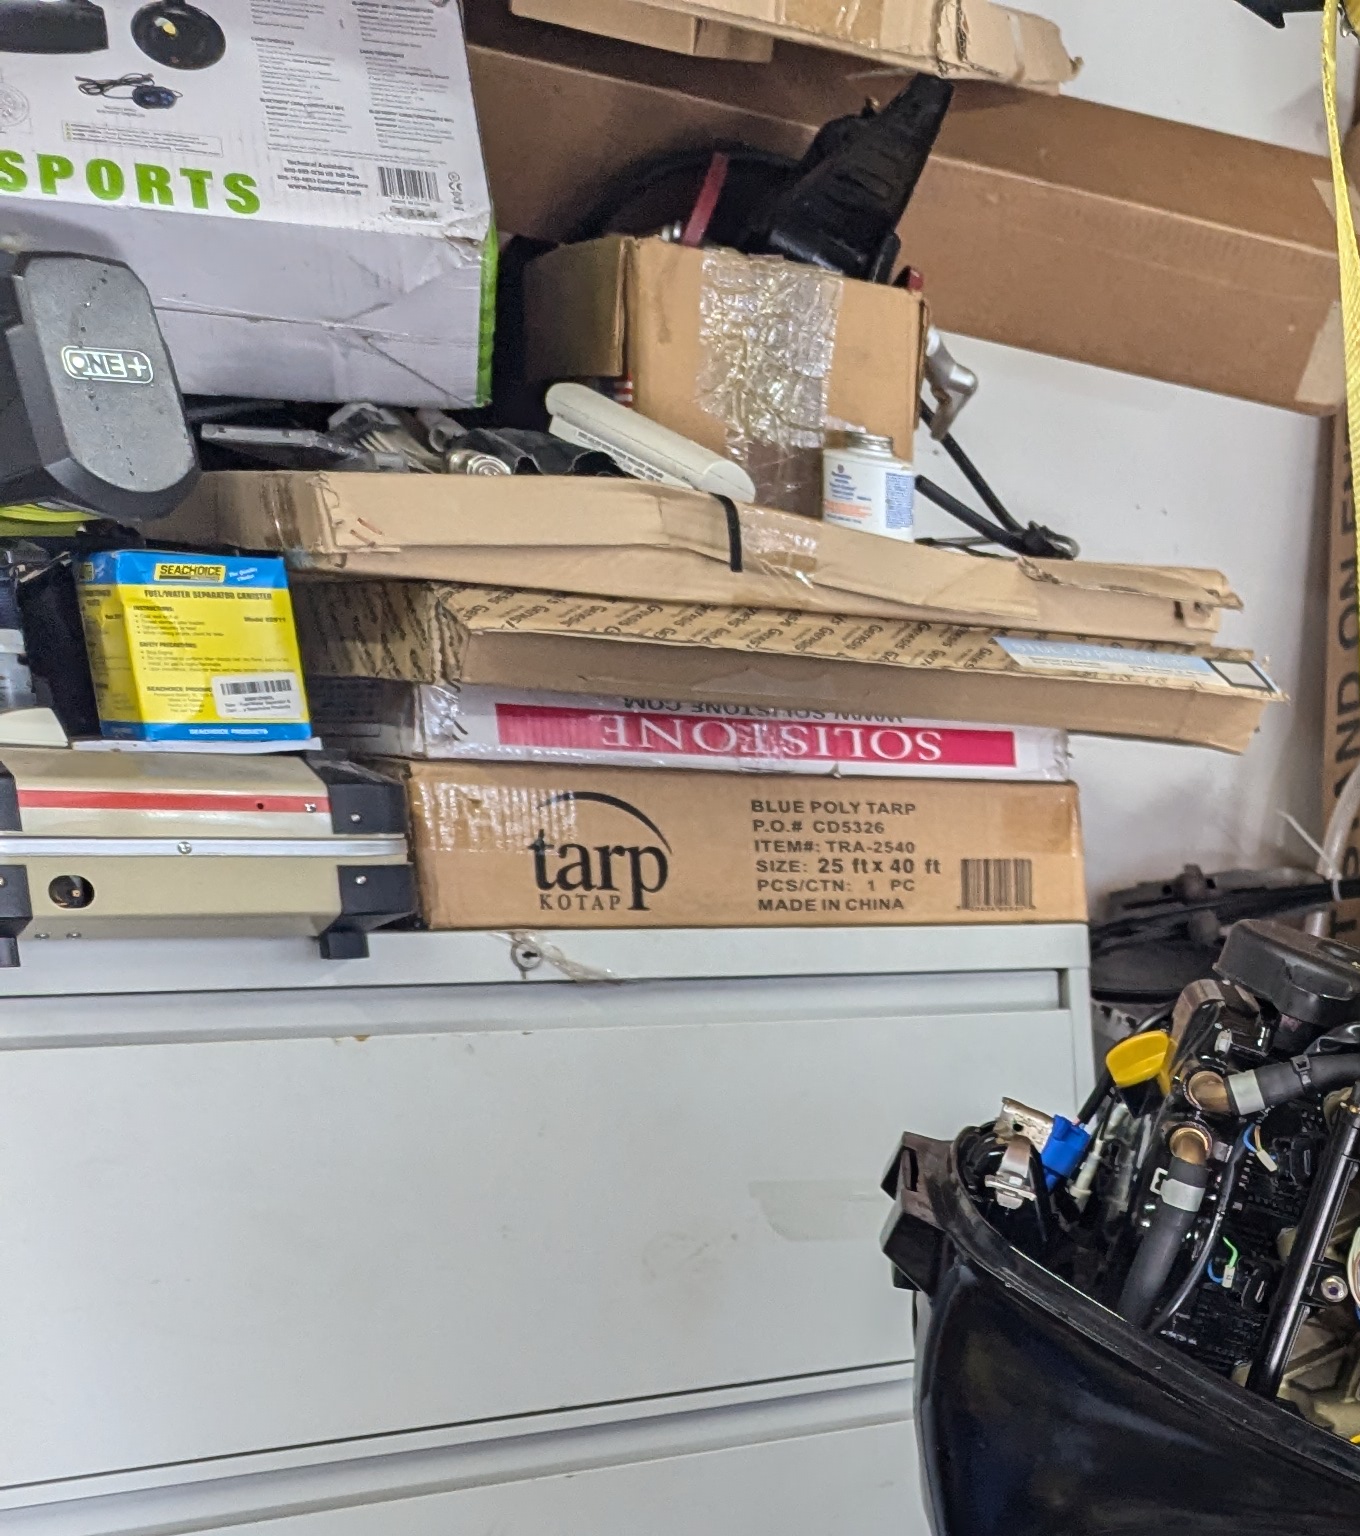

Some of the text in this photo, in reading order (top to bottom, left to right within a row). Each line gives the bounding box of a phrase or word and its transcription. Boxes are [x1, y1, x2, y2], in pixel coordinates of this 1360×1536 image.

[0, 149, 261, 215] SPORTS
[160, 565, 222, 576] SEACHOICE
[602, 715, 942, 761] SOLISTONE
[751, 800, 916, 816] BLUE POLY TARP
[753, 820, 885, 834] P.O.# CD5326
[754, 840, 915, 854] ITEM#: TRA-2540
[527, 829, 668, 911] tarp
[756, 860, 808, 873] SIZE:
[818, 858, 844, 874] 25
[890, 859, 915, 874] 40
[925, 858, 941, 874] ft
[757, 879, 915, 892] PCS/CTN: 1 PC
[540, 894, 621, 910] KOTAP
[758, 898, 904, 912] MADE IN CHINA
